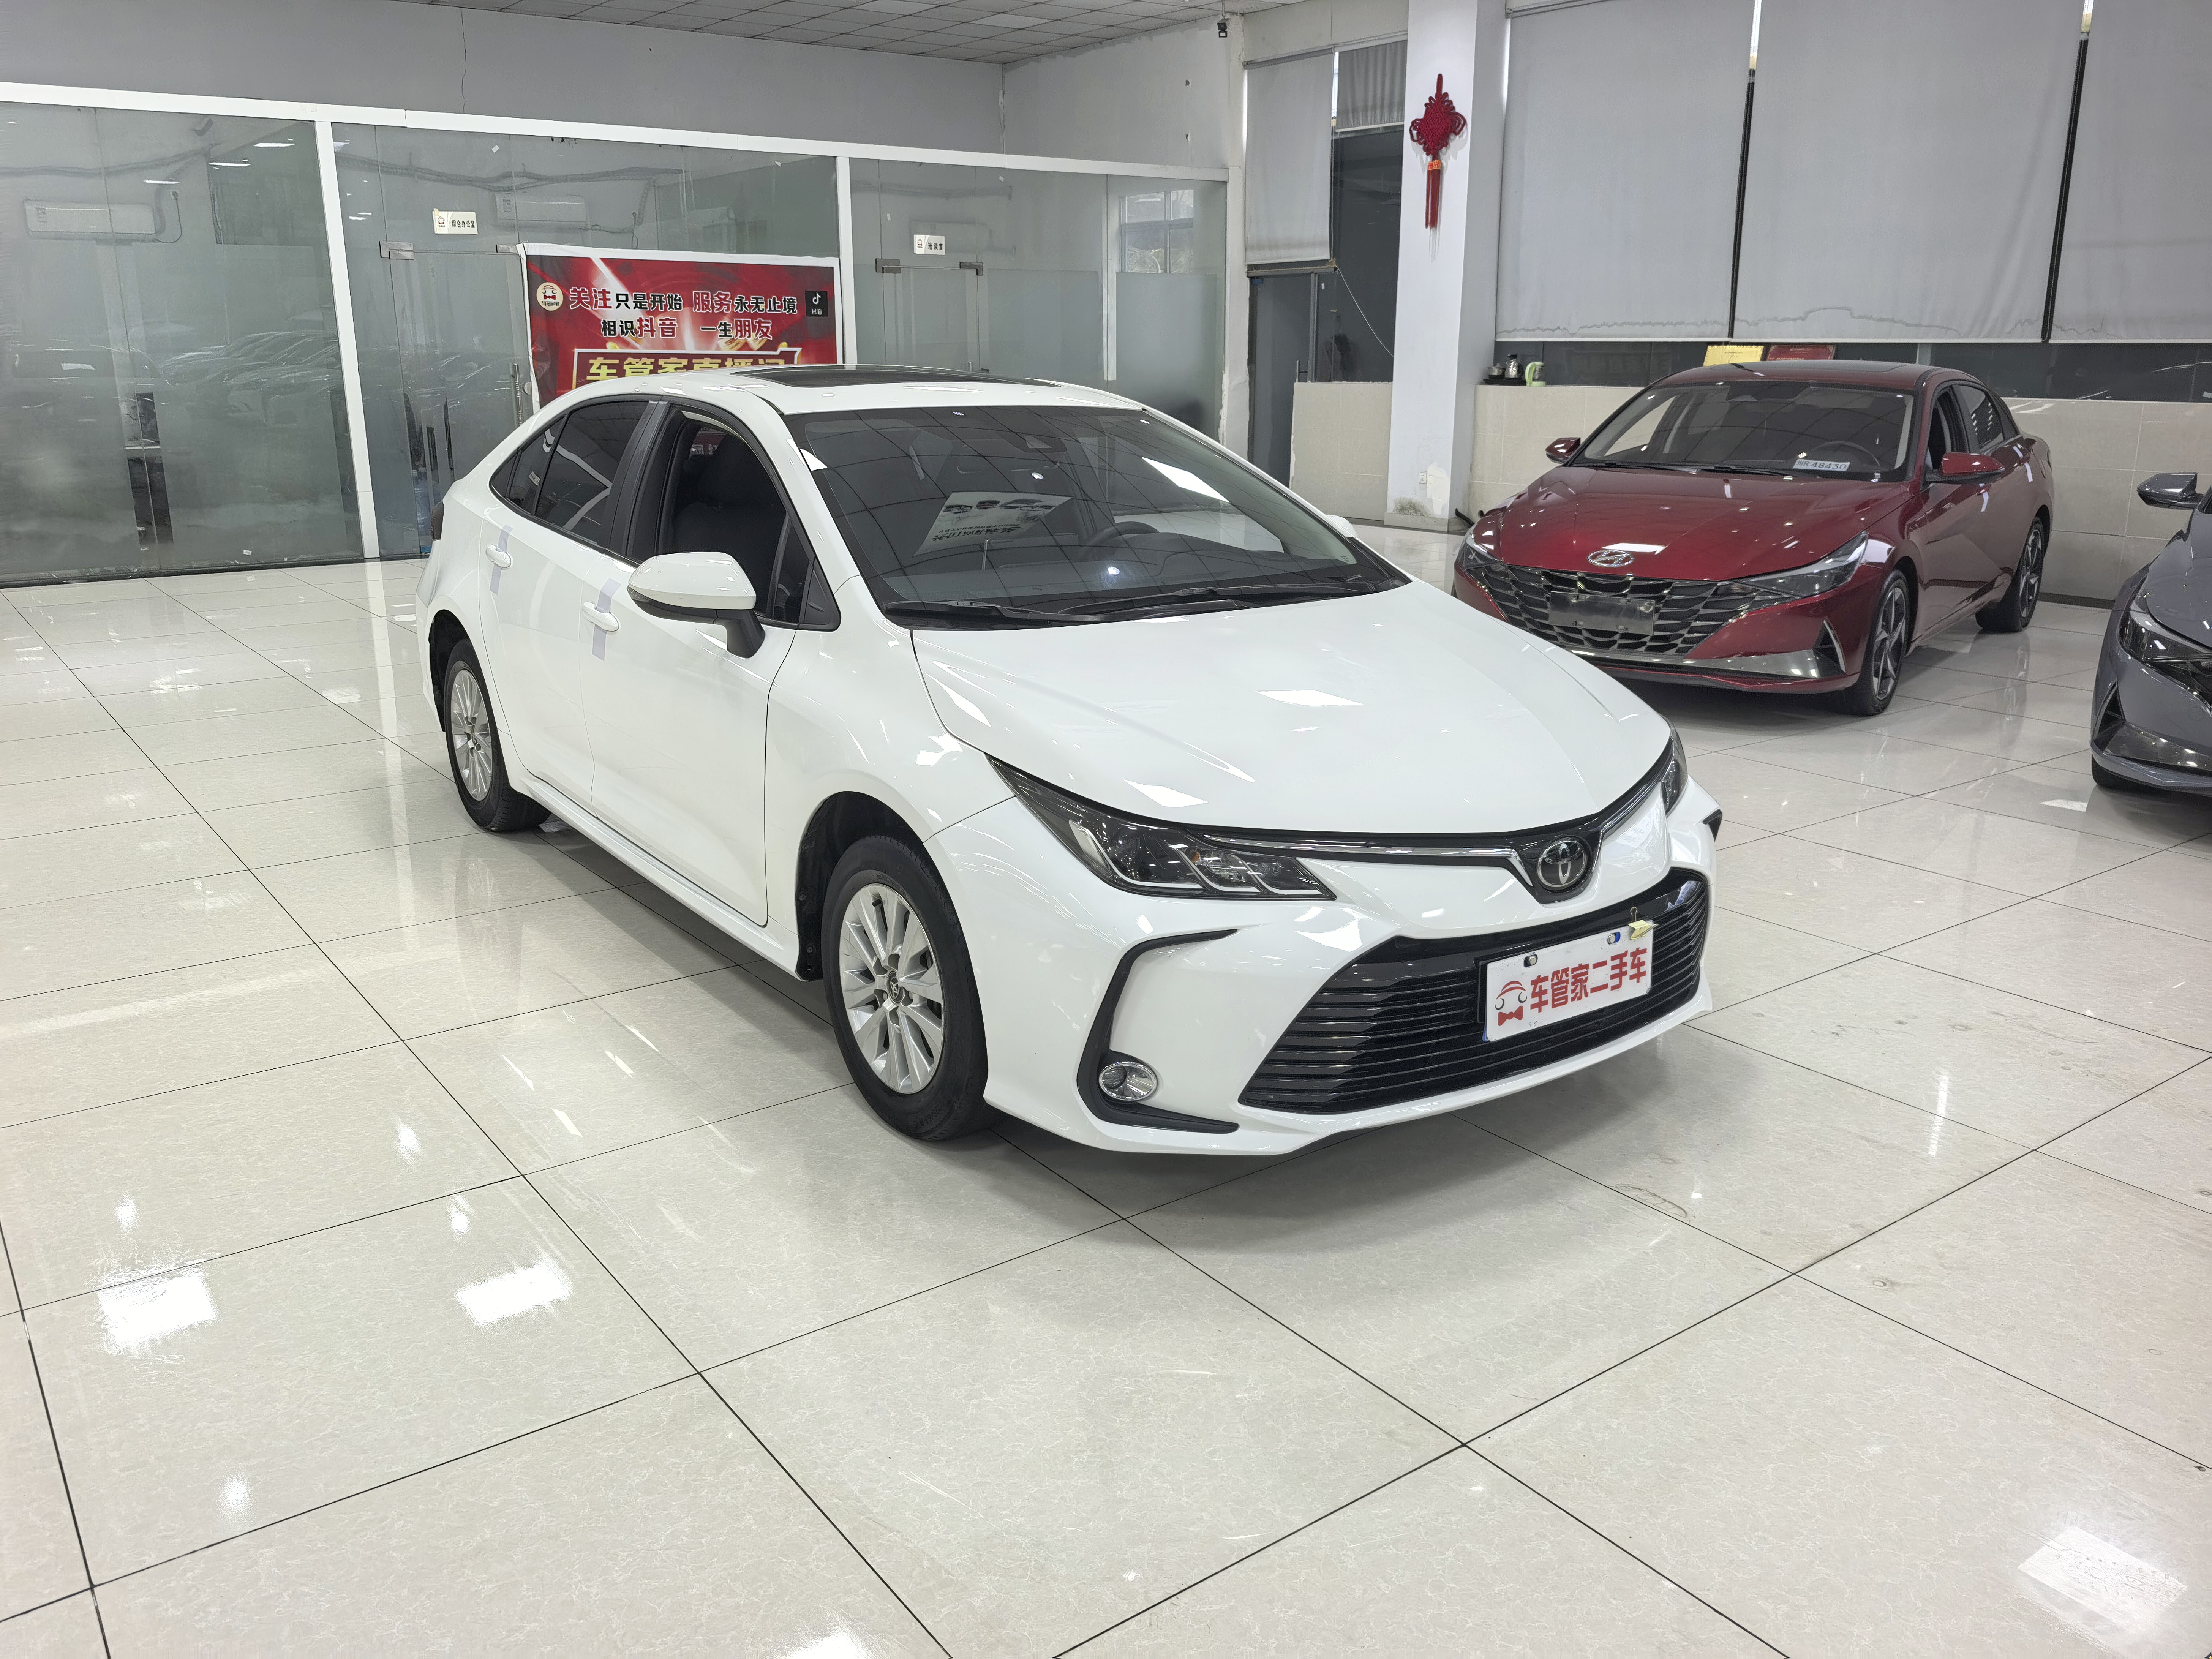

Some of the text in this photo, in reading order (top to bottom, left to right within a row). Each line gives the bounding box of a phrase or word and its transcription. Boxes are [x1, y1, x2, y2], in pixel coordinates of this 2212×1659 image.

[570, 287, 797, 314] 关注只是开始 服务永无止境
[601, 316, 772, 340] 相识抖音 一生朋友
[1530, 947, 1647, 1013] 车管家二手车
